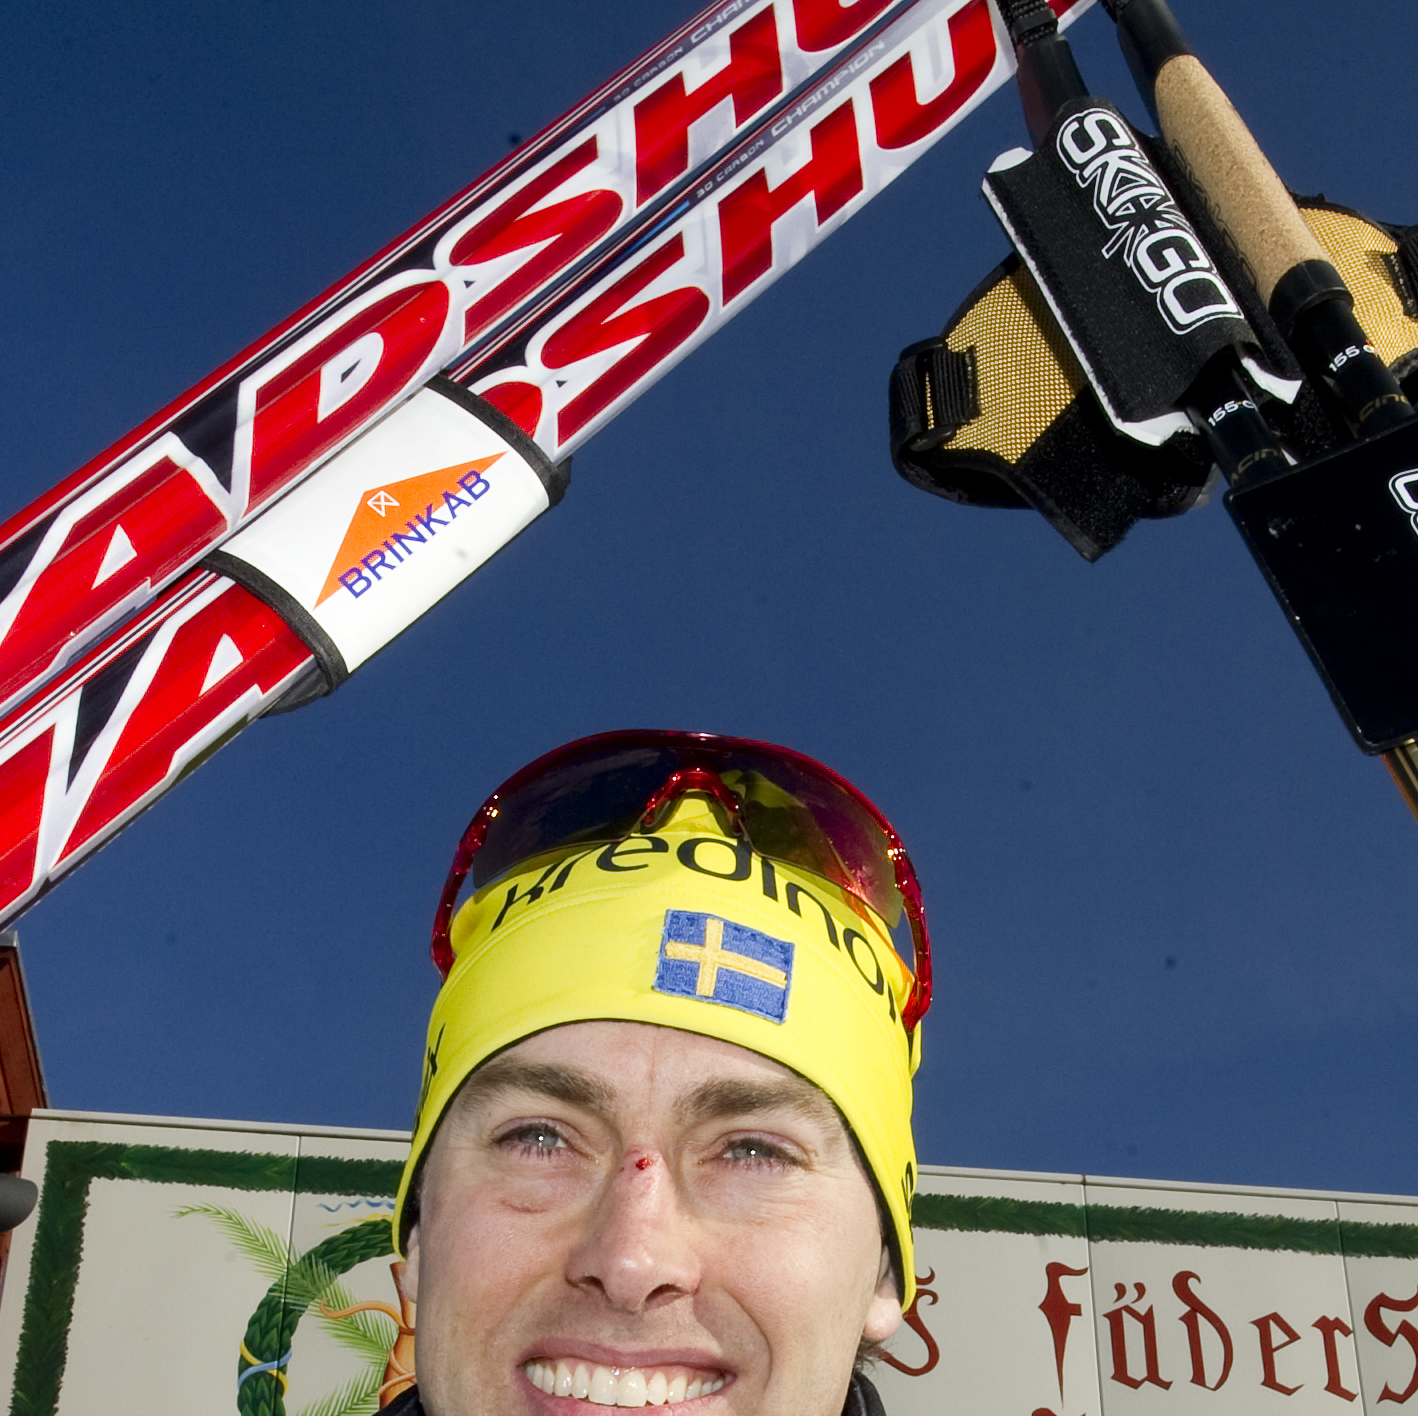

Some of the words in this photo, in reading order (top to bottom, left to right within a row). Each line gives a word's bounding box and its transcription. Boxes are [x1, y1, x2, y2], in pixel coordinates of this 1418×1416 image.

[633, 46, 684, 87] CARBON
[716, 139, 765, 184] CARBON
[770, 40, 886, 137] CHAMPION
[1328, 345, 1361, 372] 155
[1207, 400, 1240, 427] 155
[337, 470, 491, 599] BRINKAB
